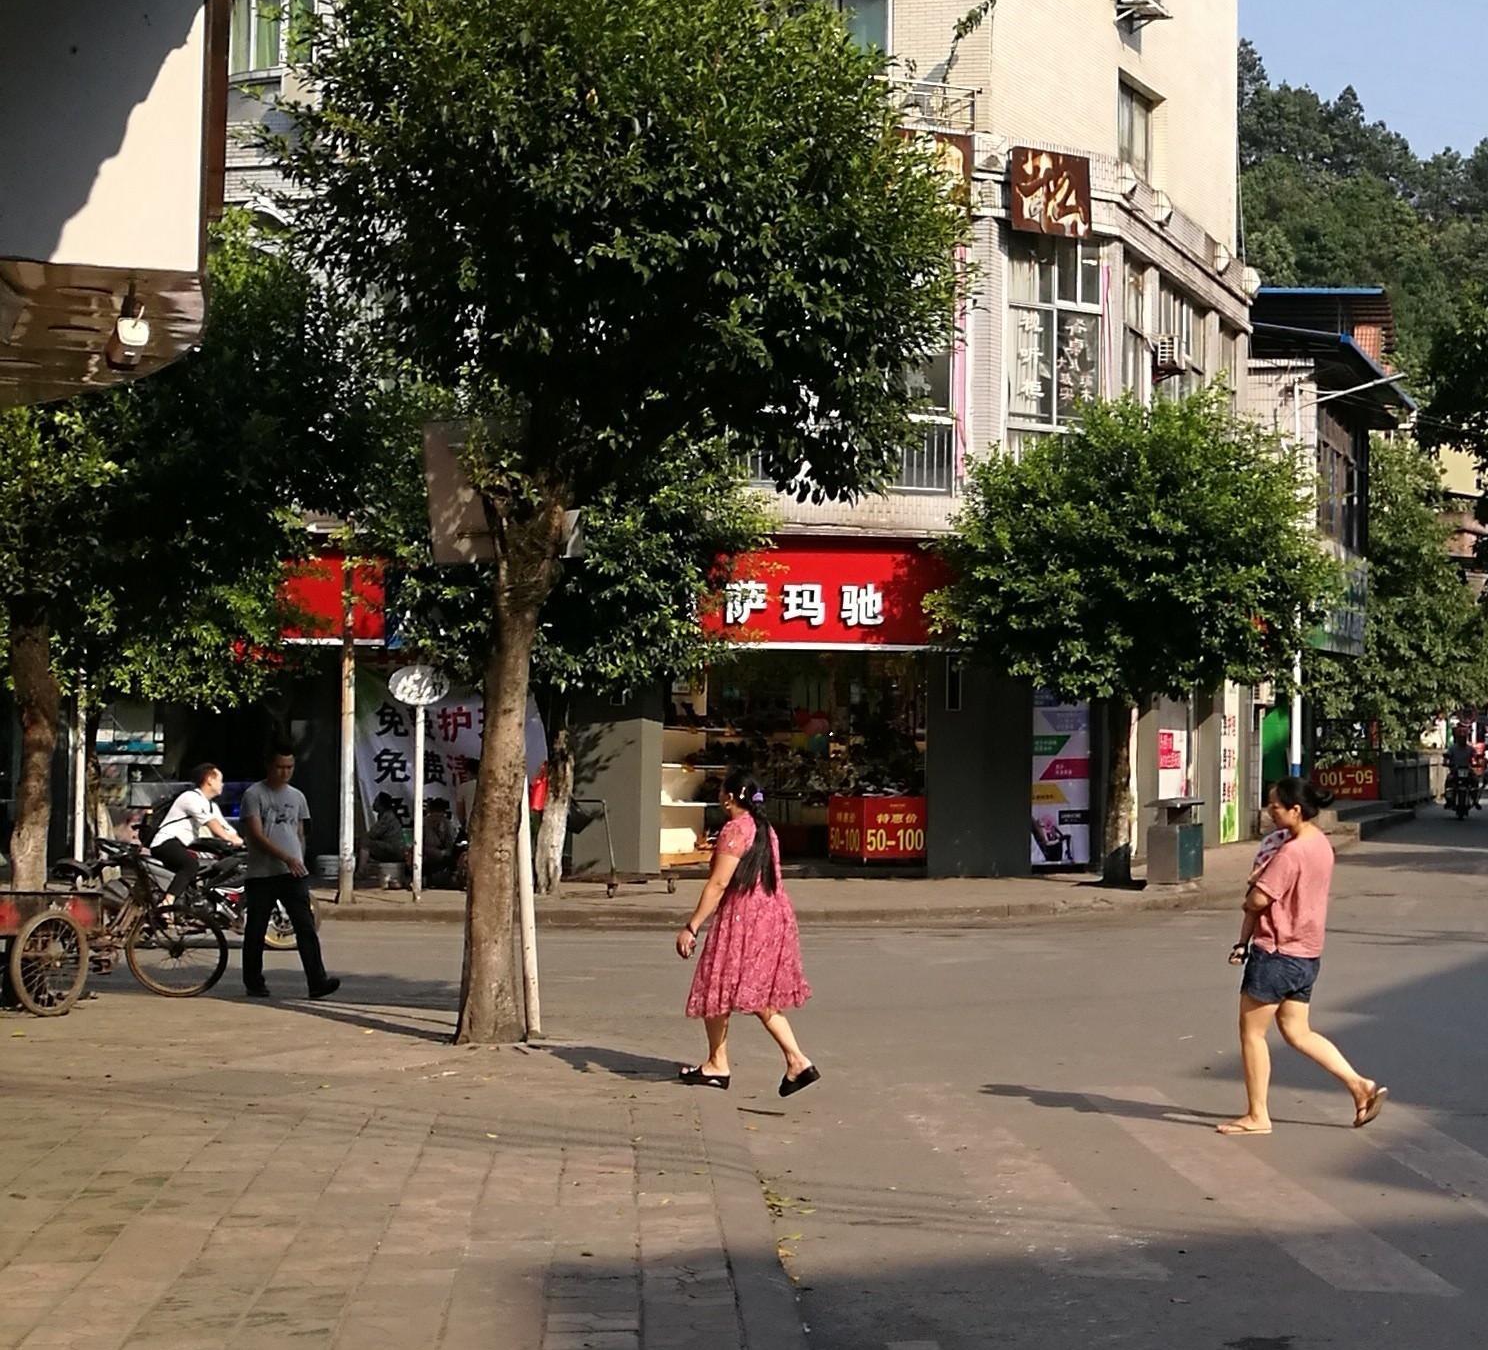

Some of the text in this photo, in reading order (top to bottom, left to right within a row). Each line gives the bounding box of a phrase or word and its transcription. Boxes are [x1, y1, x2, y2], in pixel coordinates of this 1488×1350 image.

[724, 580, 884, 627] 萨玛驰
[375, 702, 485, 742] 免费护
[875, 812, 918, 824] 特惠价
[865, 827, 925, 852] 50-100
